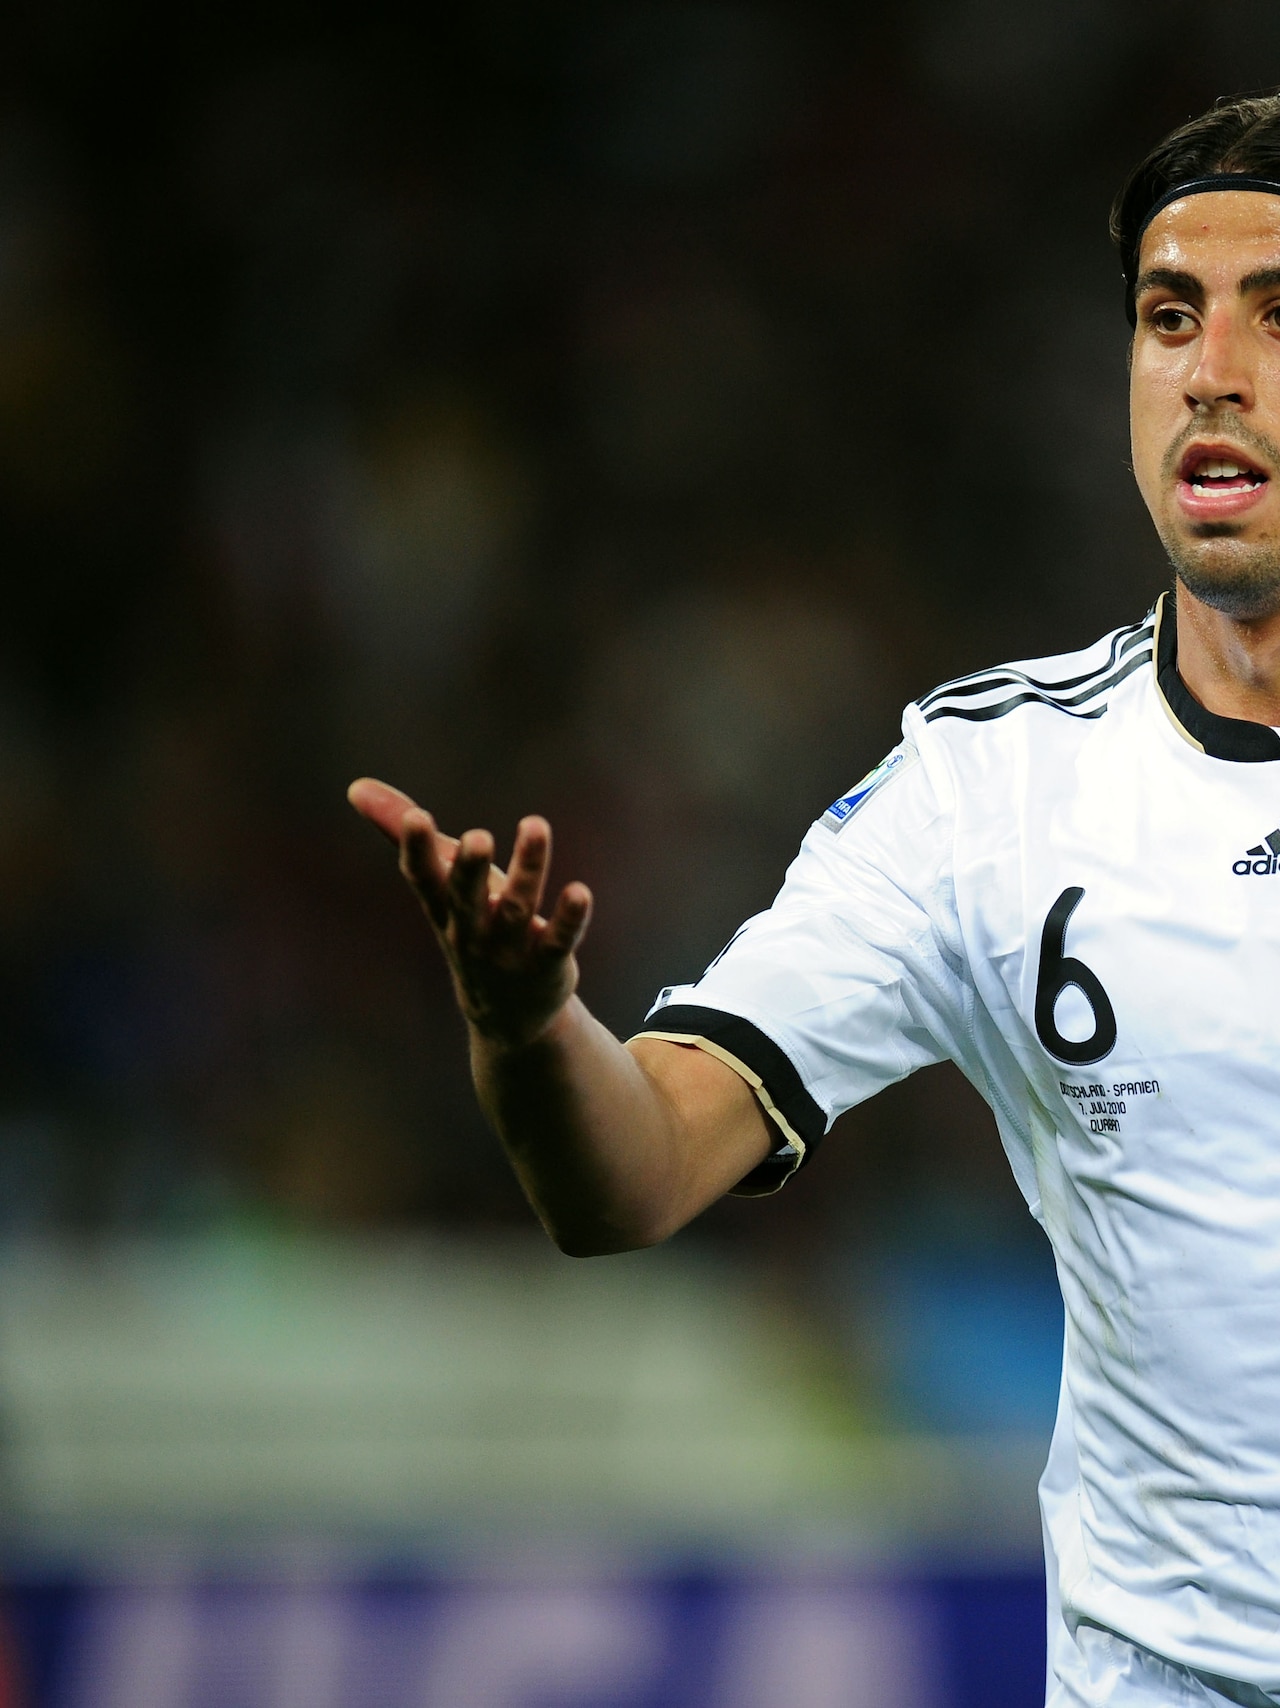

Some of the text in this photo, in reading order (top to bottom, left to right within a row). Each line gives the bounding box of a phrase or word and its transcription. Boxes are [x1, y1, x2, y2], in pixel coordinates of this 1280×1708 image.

[1034, 886, 1118, 1066] 6
[1059, 1081, 1106, 1098] DTSCHLAND
[1113, 1080, 1160, 1097] SPANIEN
[1107, 1101, 1127, 1115] 2010
